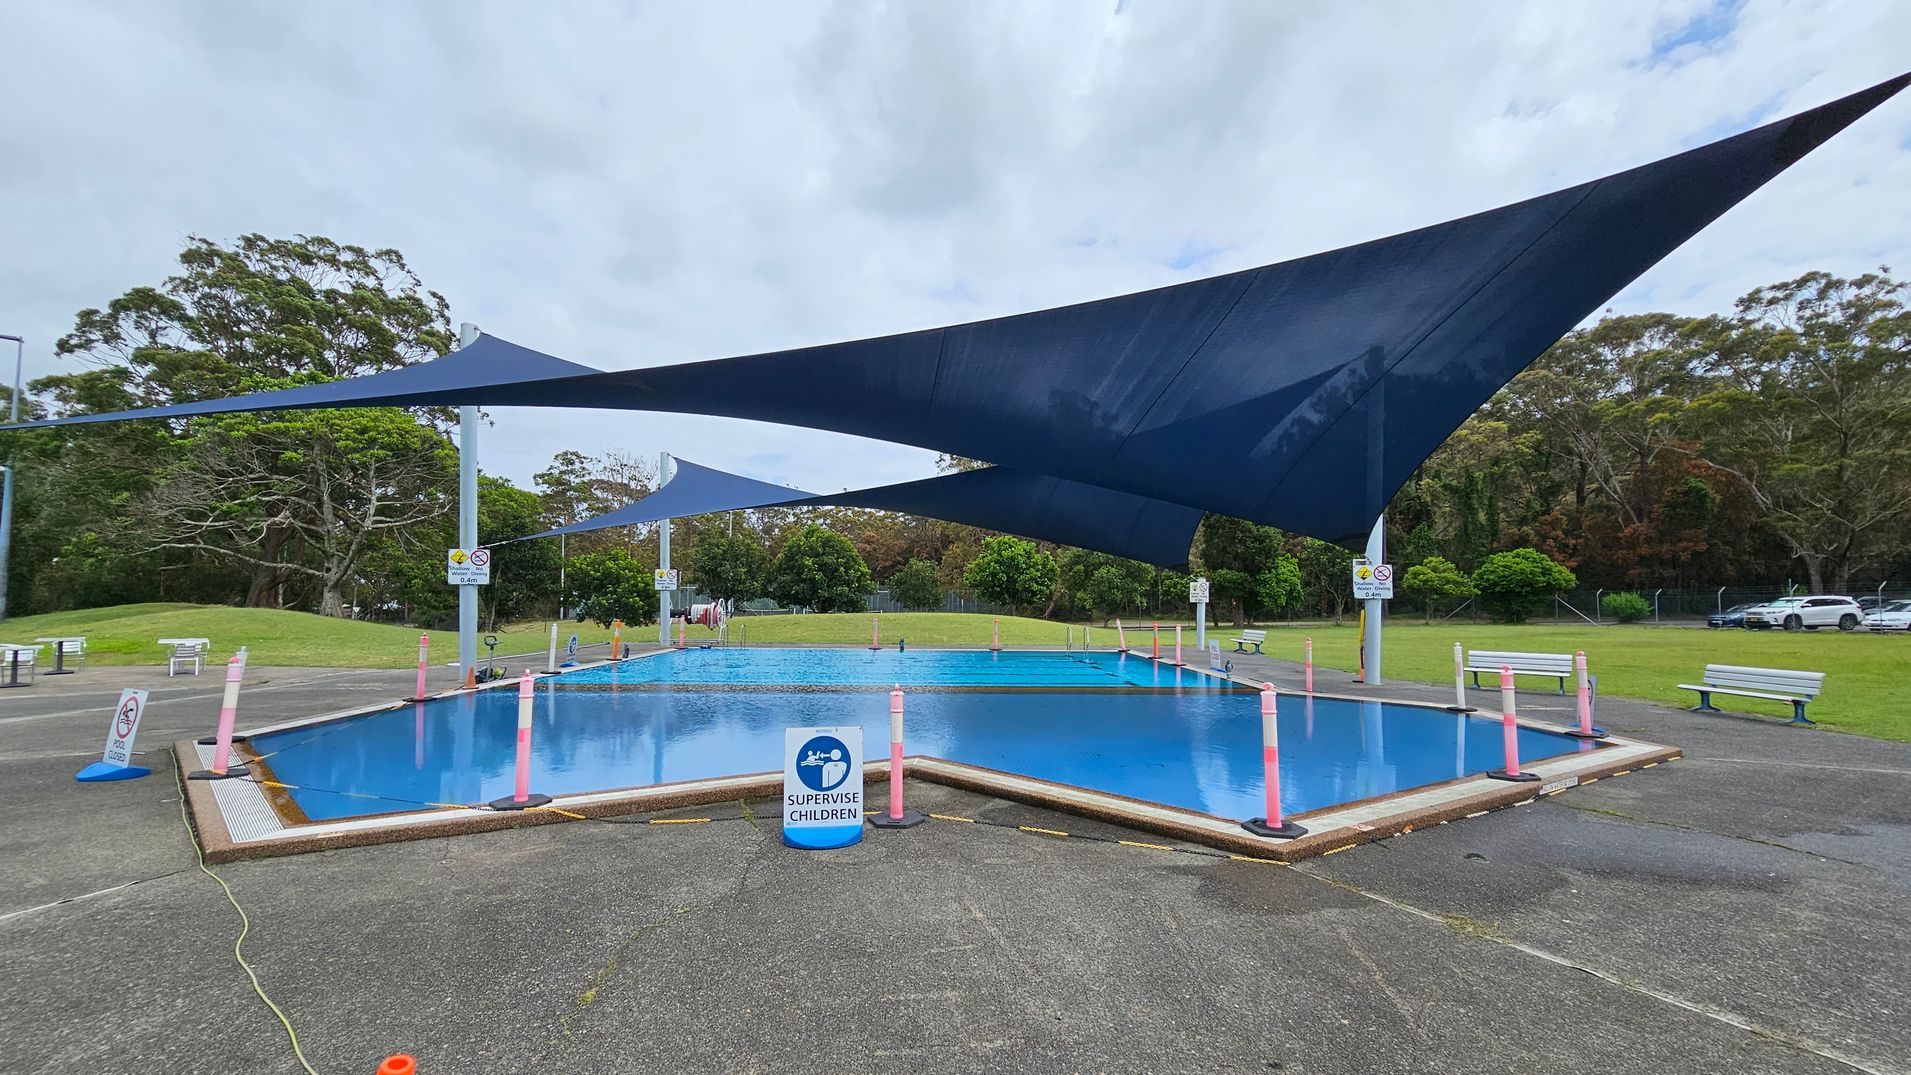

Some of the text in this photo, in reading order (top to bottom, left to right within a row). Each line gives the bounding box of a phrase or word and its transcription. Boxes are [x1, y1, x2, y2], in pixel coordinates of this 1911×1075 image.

[113, 739, 126, 750] POOL
[108, 750, 126, 762] CLOSED
[788, 792, 859, 806] SUPERVISE
[790, 808, 857, 821] CHILDREN
